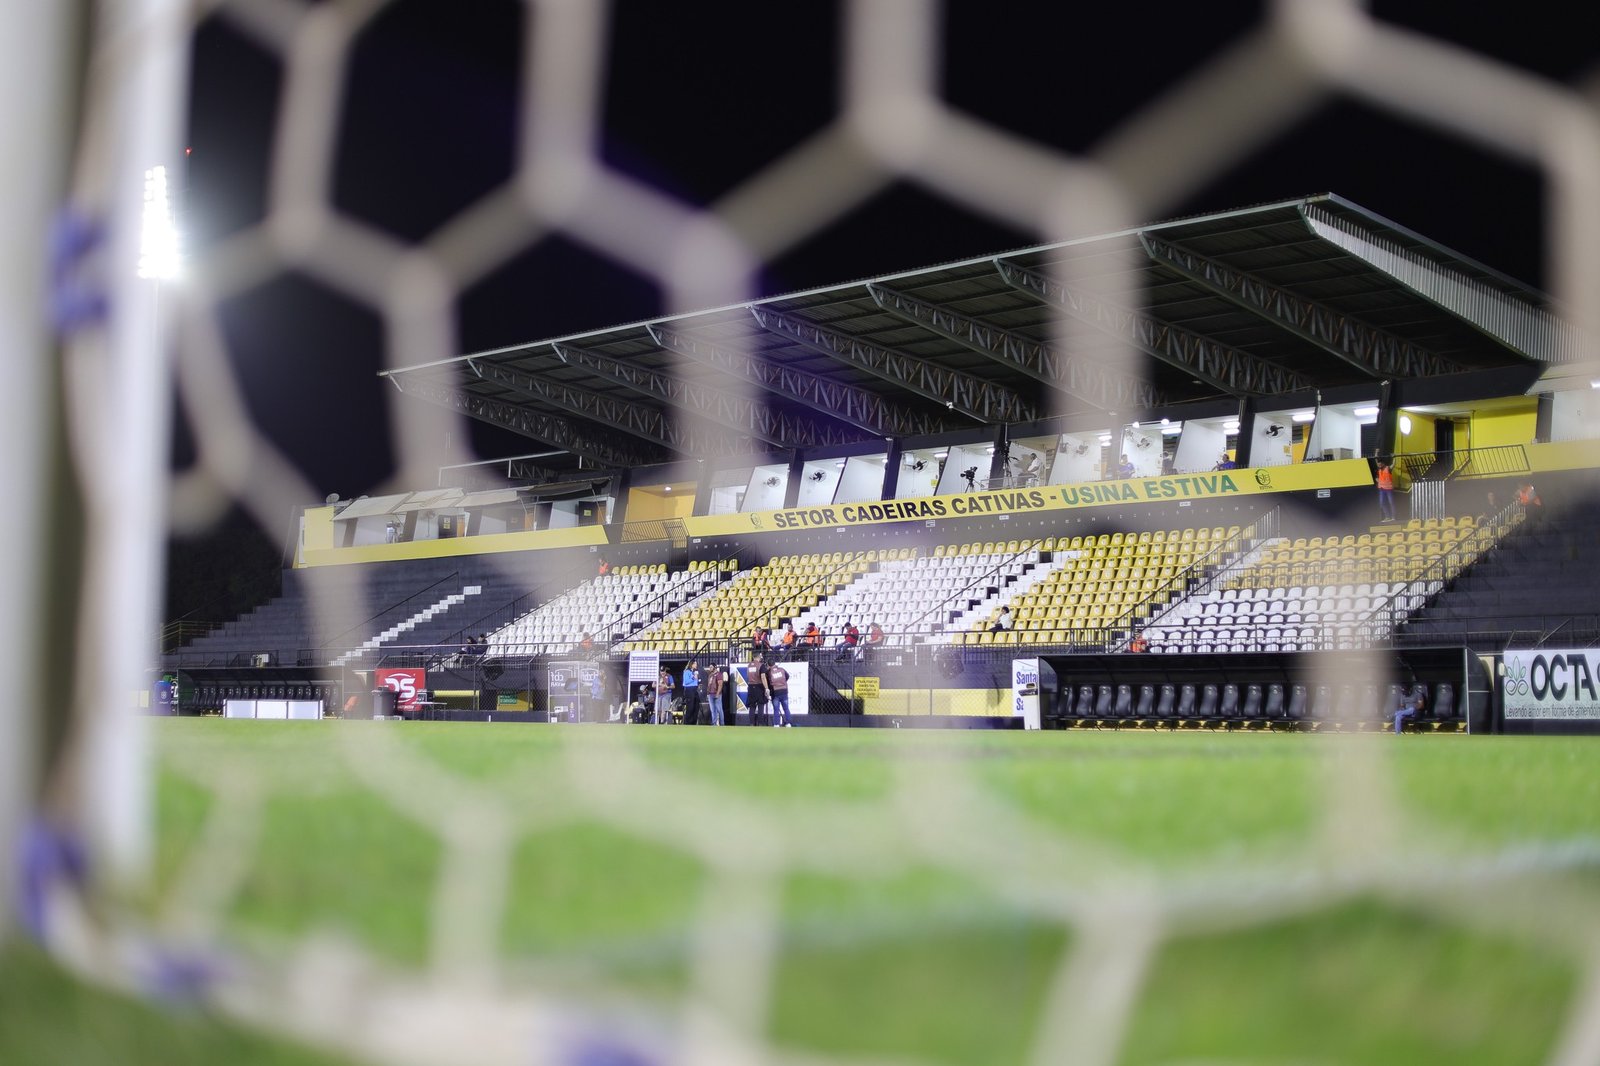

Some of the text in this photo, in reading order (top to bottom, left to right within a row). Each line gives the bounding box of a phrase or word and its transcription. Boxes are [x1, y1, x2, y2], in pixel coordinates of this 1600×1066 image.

[773, 508, 838, 529] SETOR
[842, 499, 947, 523] CADEIRAS
[951, 490, 1045, 514] CATIVAS
[1061, 483, 1138, 505] USINA
[1142, 474, 1239, 500] ESTIVA
[1530, 653, 1600, 701] OCTA
[1506, 705, 1528, 717] Levando
[1542, 707, 1551, 717] em
[1552, 704, 1567, 717] forma
[1567, 705, 1574, 716] de
